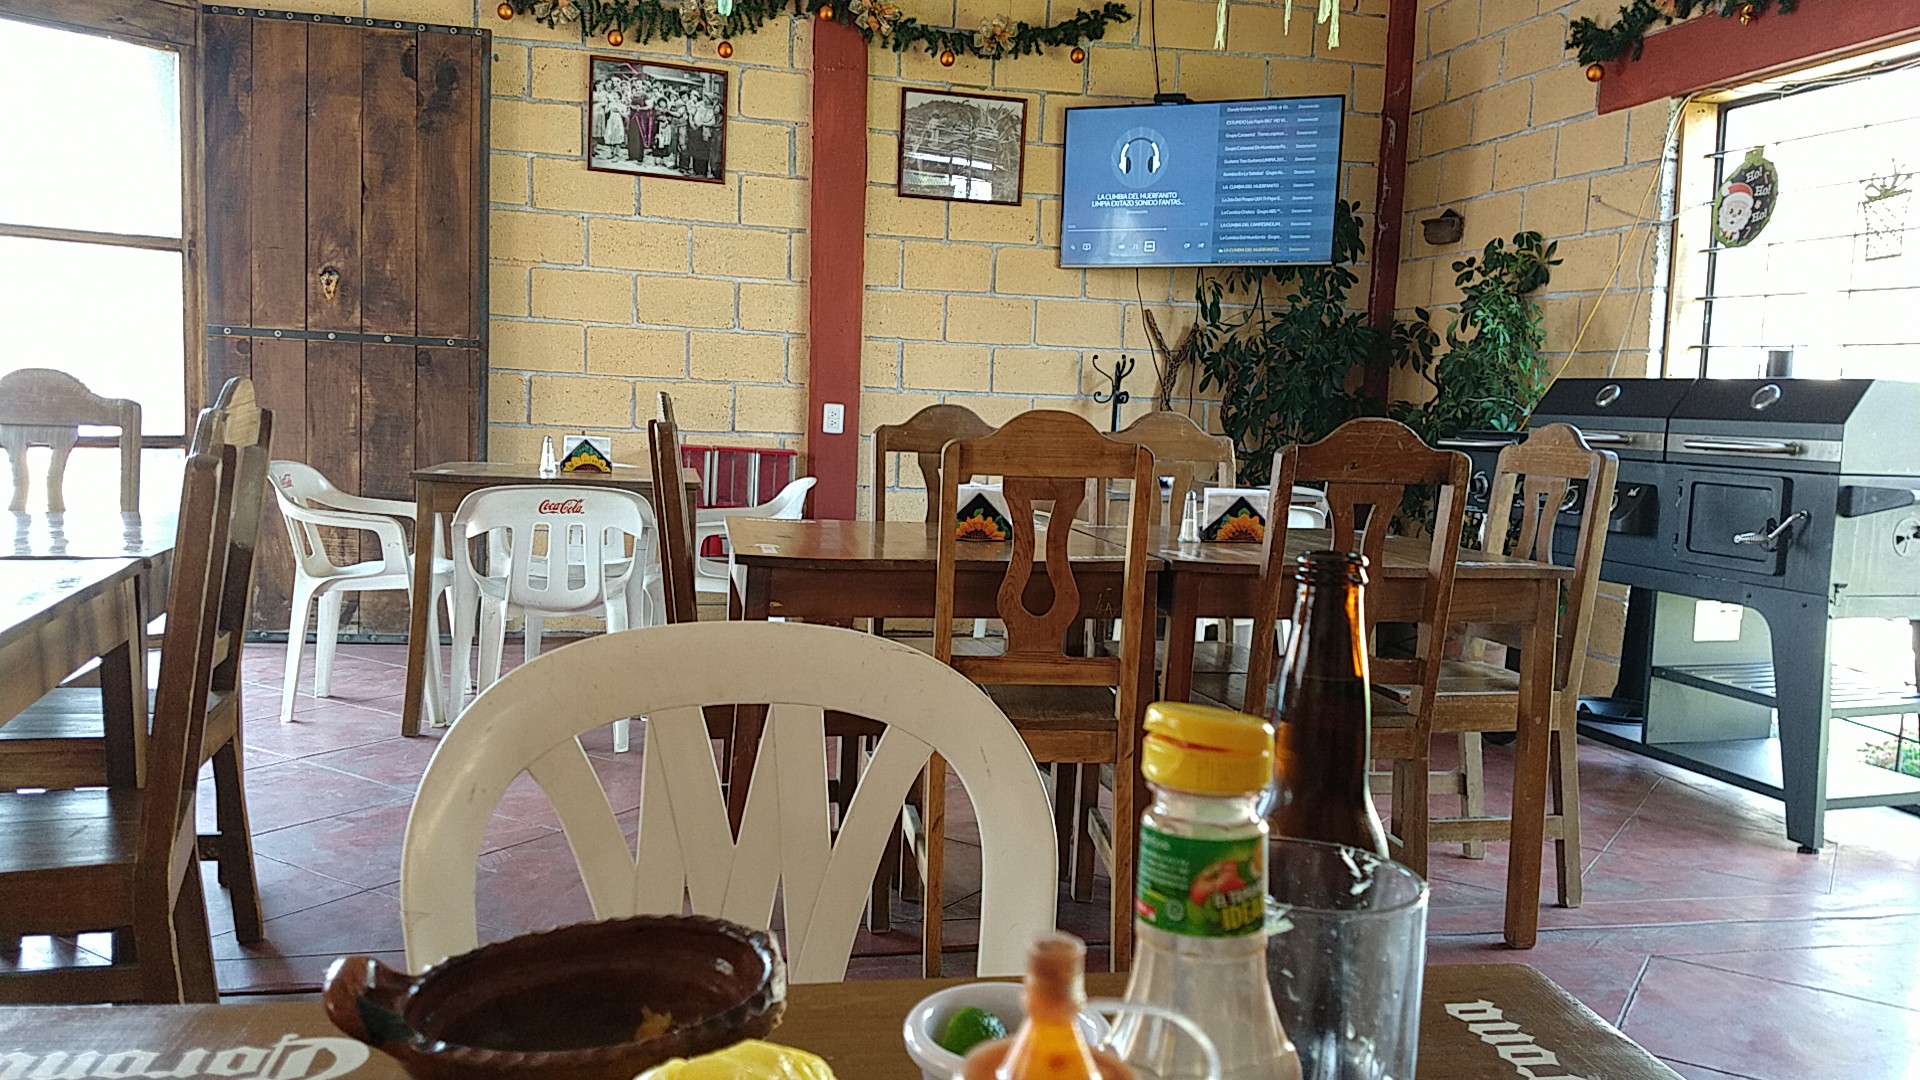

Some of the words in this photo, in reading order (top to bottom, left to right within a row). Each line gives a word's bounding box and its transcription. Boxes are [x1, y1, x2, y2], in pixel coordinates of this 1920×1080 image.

[1745, 166, 1763, 183] Ho!
[1140, 192, 1178, 200] HUERFANITO
[1754, 184, 1772, 197] Ho!
[1091, 200, 1111, 208] LIMPIA
[1751, 208, 1767, 223] Ho!
